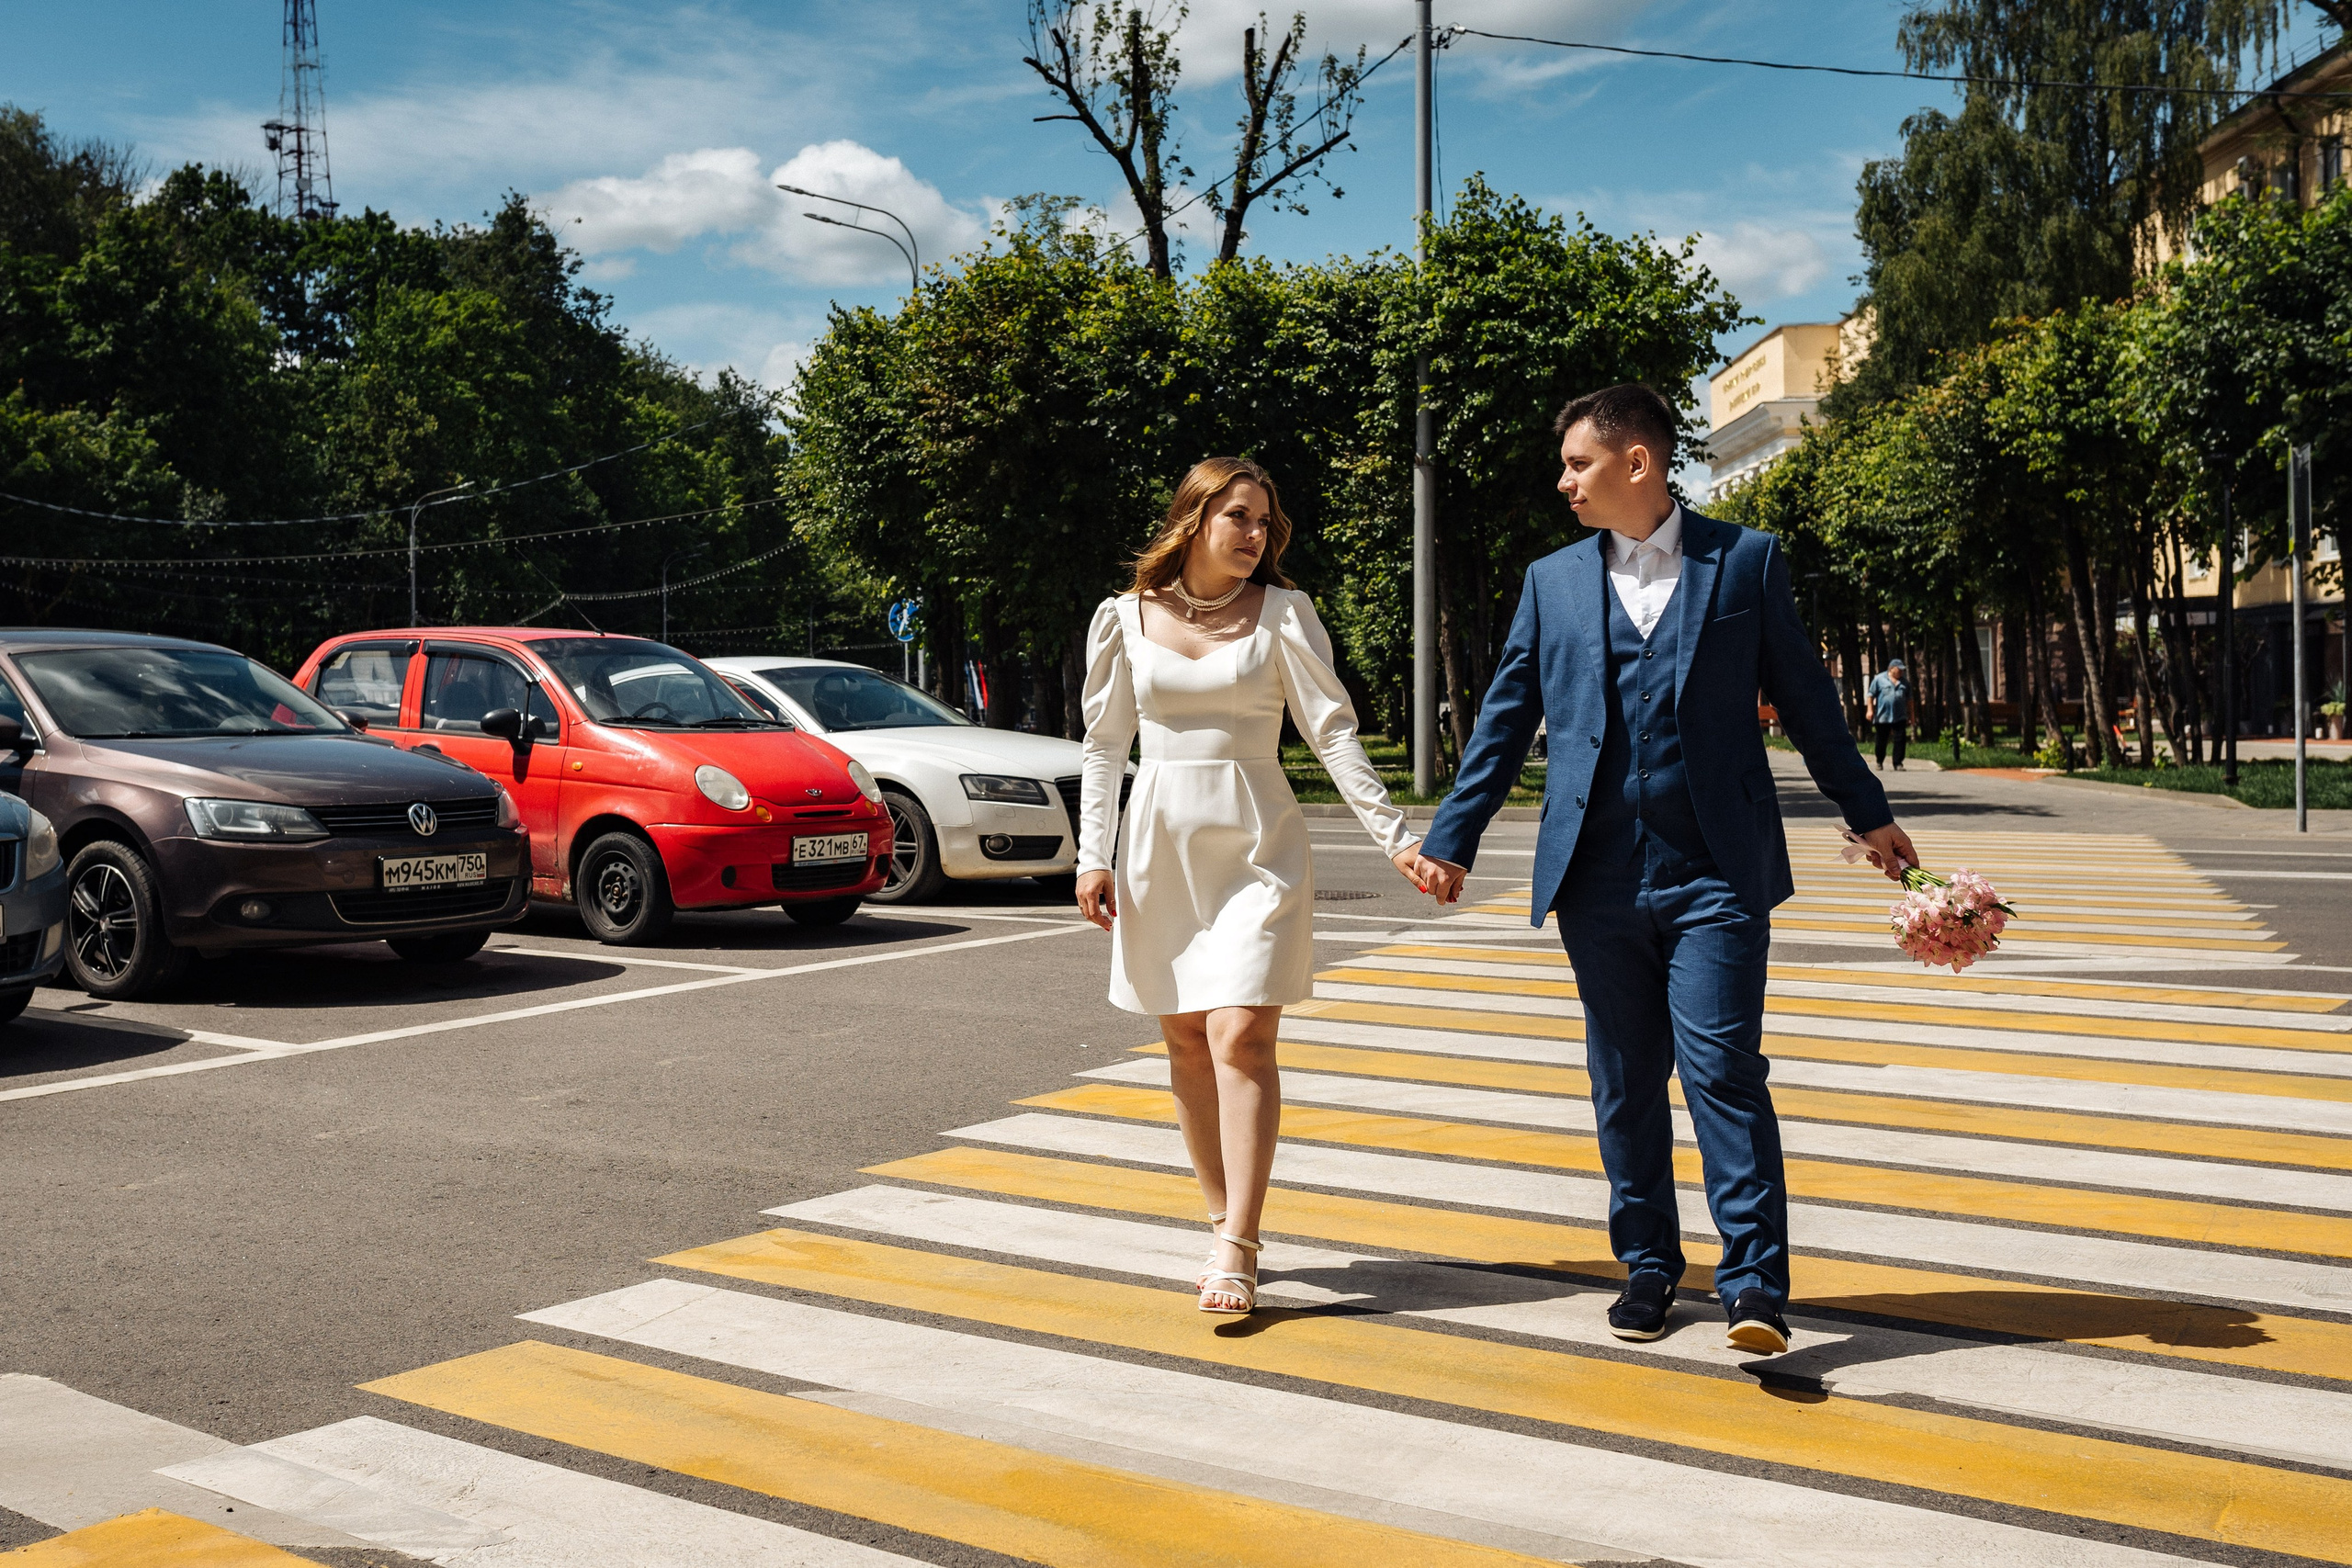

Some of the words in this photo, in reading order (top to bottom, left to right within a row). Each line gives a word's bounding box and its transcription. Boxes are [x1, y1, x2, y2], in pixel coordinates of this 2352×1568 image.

[853, 835, 865, 849] 67
[389, 860, 457, 884] М945КМ
[459, 855, 482, 873] 750
